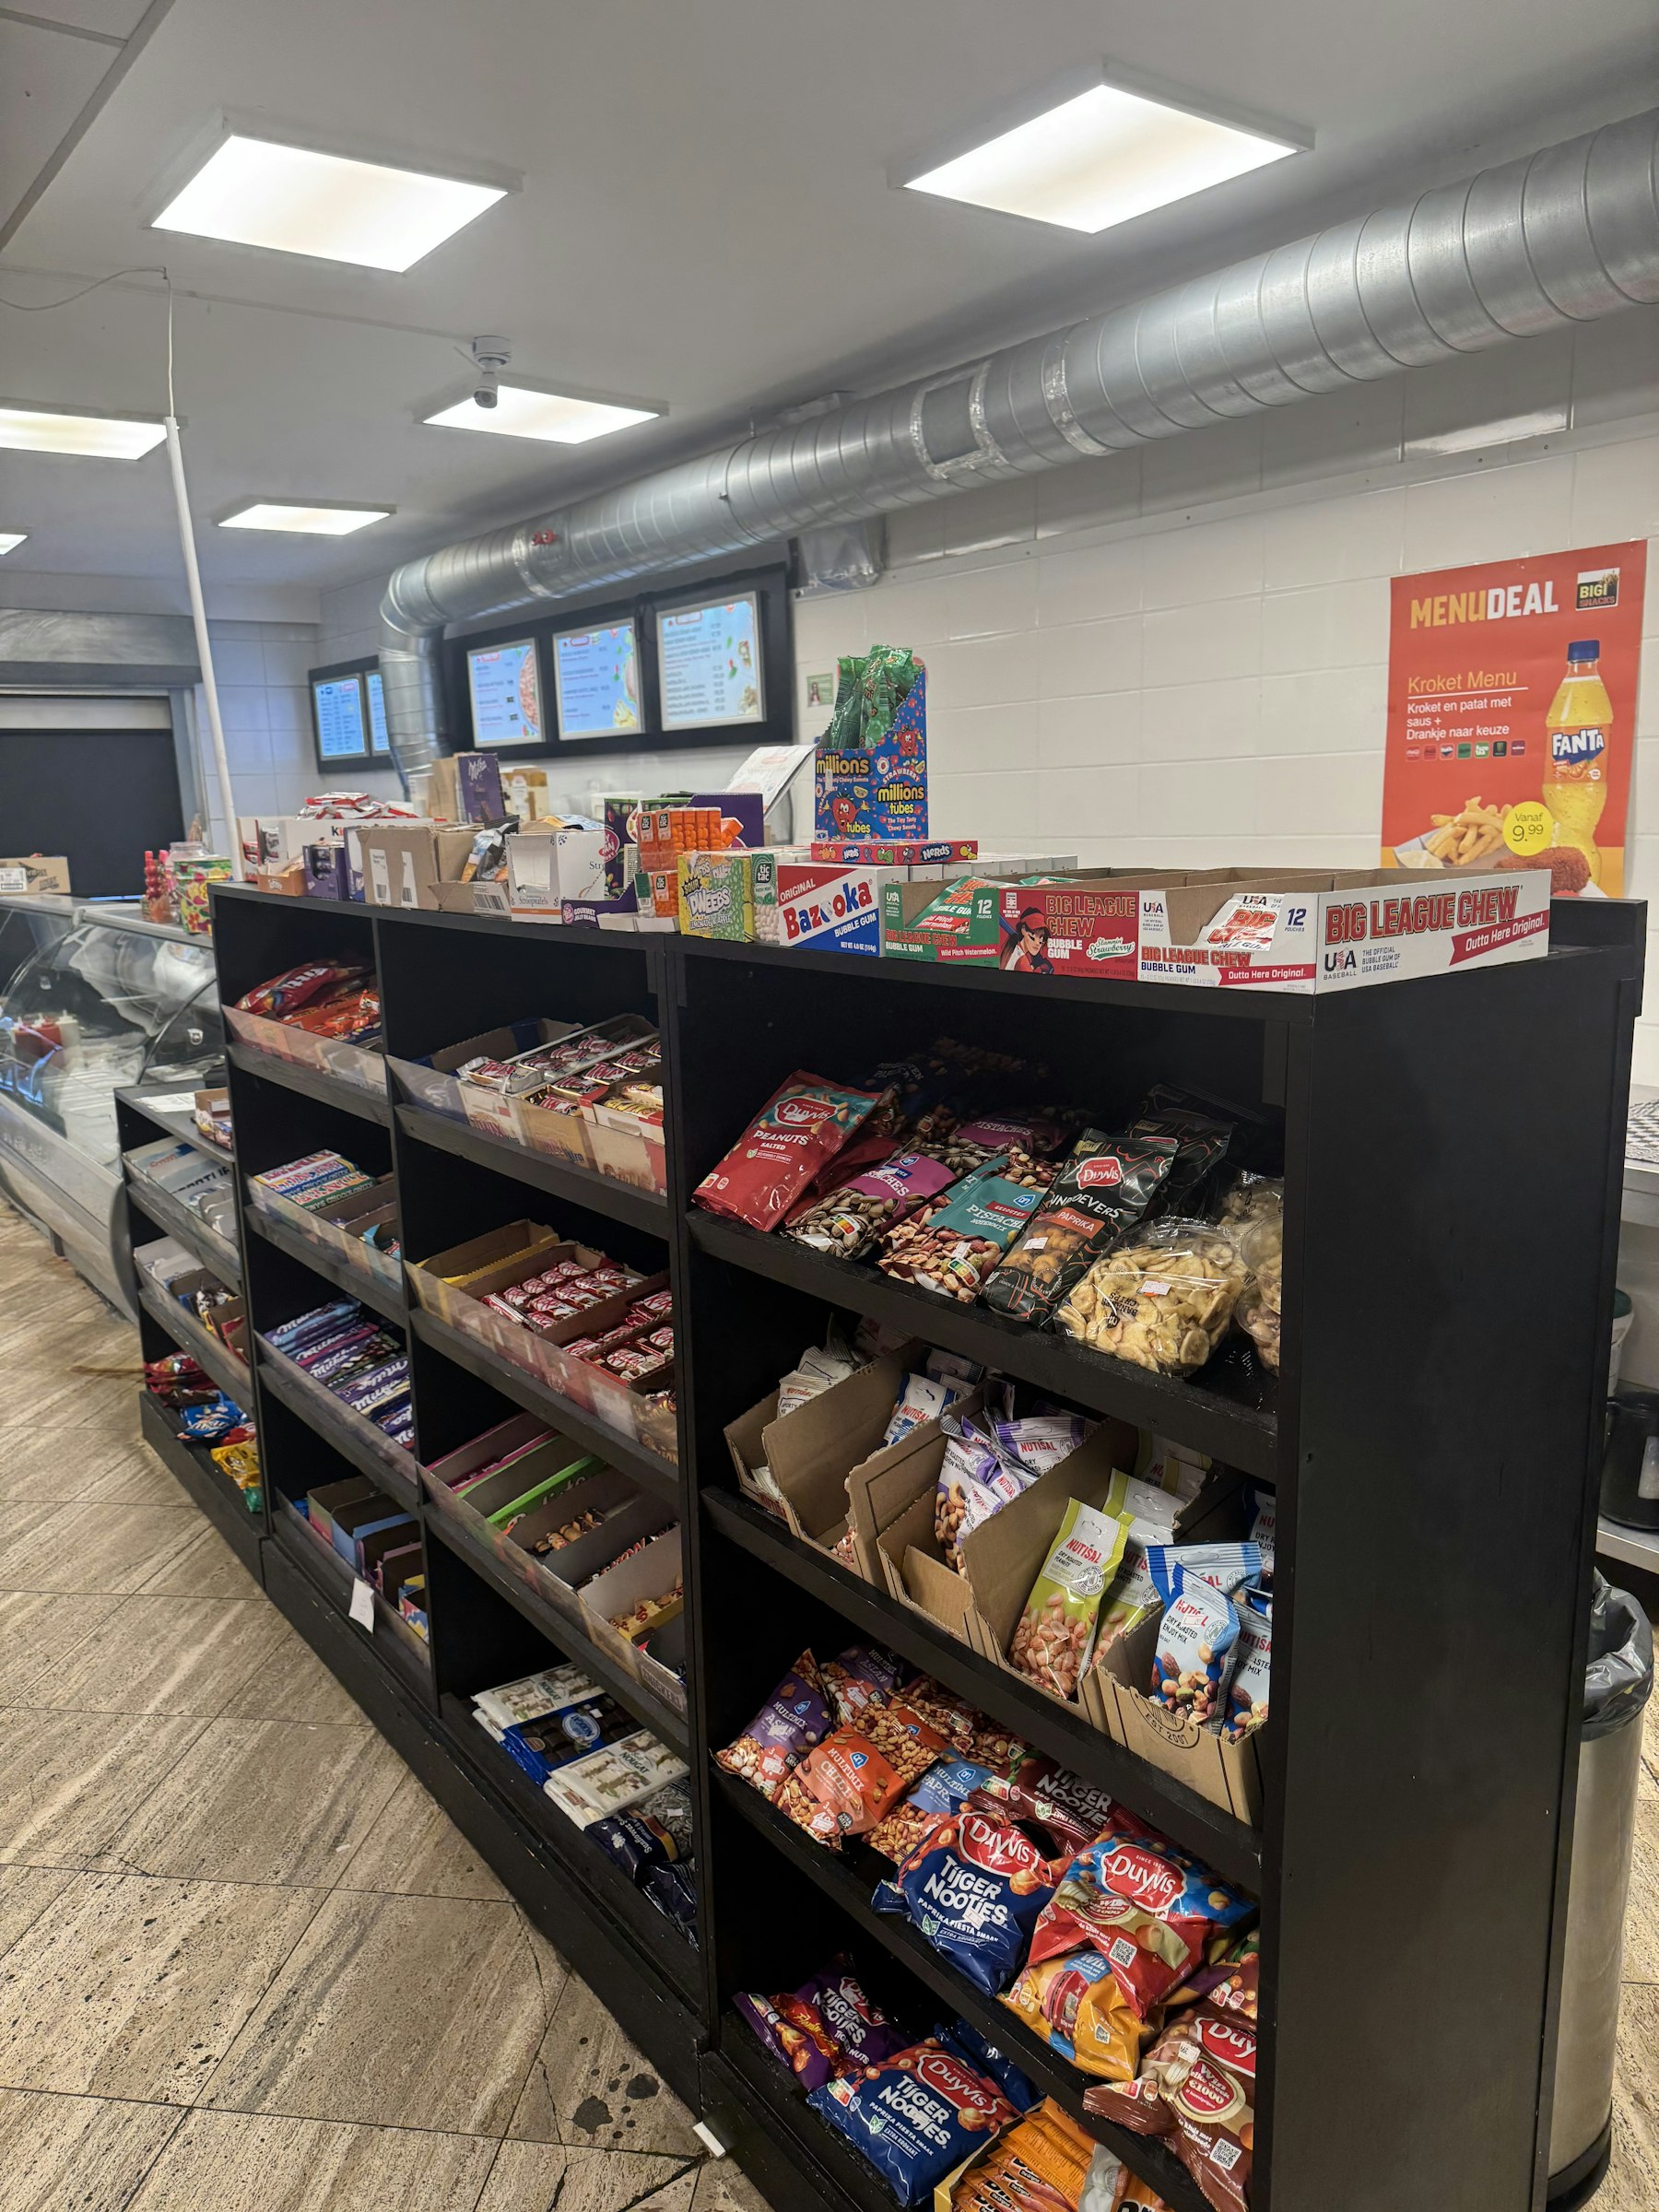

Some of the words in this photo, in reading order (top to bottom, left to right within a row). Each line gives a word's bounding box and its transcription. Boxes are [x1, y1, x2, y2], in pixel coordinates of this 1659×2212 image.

[1579, 583, 1608, 599] BIGI
[1410, 581, 1559, 629] MENUDEAL
[1578, 595, 1616, 608] SNACKS
[1407, 674, 1462, 694] Kroket
[1467, 671, 1517, 688] Menu
[1407, 700, 1441, 714] Kroket
[1443, 701, 1458, 712] en
[1460, 698, 1488, 713] patat
[1489, 697, 1512, 709] met
[1406, 717, 1432, 728] saus
[1406, 729, 1447, 743] Drankje
[1449, 727, 1474, 738] naar
[1476, 724, 1510, 735] keuze
[1551, 728, 1605, 757] FANTA
[882, 767, 921, 785] STRAWBERRY
[877, 782, 925, 803] millions
[889, 802, 914, 816] tubes
[1513, 811, 1544, 823] Vanaf
[846, 820, 871, 834] tubes
[757, 872, 770, 881] tac
[759, 865, 771, 874] tic
[780, 878, 817, 901] ORIGINAL
[688, 886, 731, 917] DWEEBS
[977, 899, 993, 914] 12
[1045, 895, 1072, 915] BIG
[1075, 896, 1135, 918] LEAGUE
[573, 907, 596, 916] GOURMET
[1287, 908, 1307, 926] 12
[1324, 900, 1368, 946] BIG
[1370, 892, 1456, 939] LEAGUE
[1457, 885, 1521, 926] CHEW
[833, 921, 860, 938] BUBBLE
[859, 912, 877, 927] GUM
[1047, 916, 1095, 937] CHEW
[886, 929, 899, 942] BIG
[899, 930, 932, 945] LEAGUE
[932, 932, 957, 947] CHEW
[1047, 937, 1083, 950] BUBBLE
[1465, 935, 1489, 952] Outta
[1490, 928, 1511, 943] Here
[885, 941, 908, 952] BUBBLE
[908, 943, 924, 953] GUM
[1047, 948, 1070, 959] GUM
[1088, 941, 1135, 957] Strawberry
[1372, 946, 1395, 955] OFFICIAL
[1141, 946, 1161, 962] BIG
[1162, 947, 1210, 966] LEAGUE
[1210, 950, 1252, 968] CHEW
[1361, 956, 1381, 965] BUBBLE
[1141, 961, 1174, 973] BUBBLE
[1176, 963, 1196, 974] GUM
[1228, 971, 1250, 980] Outta
[1252, 969, 1270, 979] Here
[1324, 971, 1358, 981] BASEBALL
[1361, 965, 1372, 973] USA
[753, 1129, 810, 1146] PEANUTS
[760, 1142, 786, 1151] SALTED
[1083, 1166, 1120, 1183] Duyvis
[1057, 1211, 1095, 1232] PAPRIKA
[1020, 1441, 1058, 1453] NUTISAL
[1024, 1458, 1036, 1466] DRY
[1058, 1550, 1067, 1559] DRY
[1066, 1555, 1083, 1567] ROASTED
[1065, 1538, 1102, 1564] NUTISAL
[1053, 1556, 1072, 1568] PEANUTS
[1166, 1615, 1179, 1628] DRY
[1162, 1625, 1179, 1640] ENJOY
[1178, 1632, 1188, 1645] MIX
[1248, 1665, 1263, 1677] MIX
[539, 1680, 562, 1701] NOUGAT
[772, 1700, 807, 1730] MULTIMIX
[571, 1713, 595, 1737] NOUGAT
[1145, 1712, 1164, 1734] EST
[1166, 1732, 1189, 1747] 2007
[768, 1747, 776, 1756] 3
[619, 1750, 650, 1774] NOUGAT
[828, 1747, 865, 1792] MULTIMIX
[822, 1801, 830, 1809] 3
[838, 1818, 851, 1830] MIX
[624, 1822, 653, 1854] Sunflower
[1135, 1854, 1151, 1865] SINCE
[1111, 1854, 1176, 1895] Duyvis
[917, 1898, 950, 1925] PAPRIKA
[848, 2048, 870, 2065] NUTS
[927, 2060, 988, 2108] Duyvis
[1200, 2063, 1228, 2091] Win
[1188, 2079, 1225, 2106] €1000
[868, 2101, 897, 2124] PAPRIKA
[895, 2120, 918, 2142] FIESTA
[916, 2138, 935, 2157] SMAAK
[1183, 2121, 1199, 2136] kluis
[1198, 2131, 1213, 2142] met
[883, 2127, 899, 2141] EXTRA
[897, 2137, 919, 2158] KROKANT
